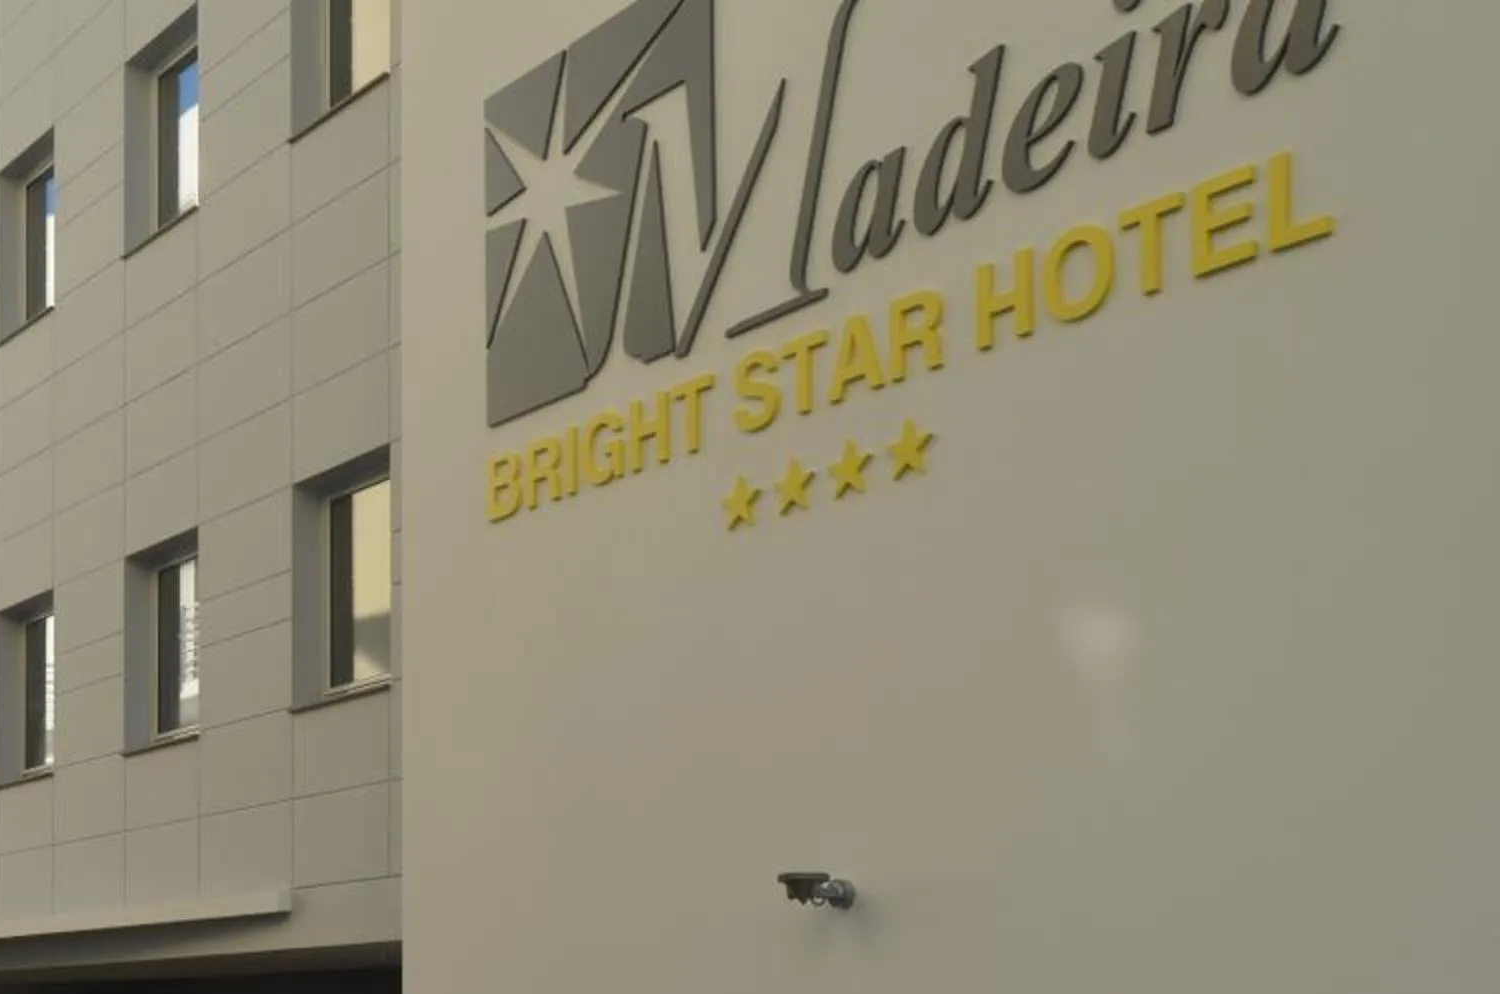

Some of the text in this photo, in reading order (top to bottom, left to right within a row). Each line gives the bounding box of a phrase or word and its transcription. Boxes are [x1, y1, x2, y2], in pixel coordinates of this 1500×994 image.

[484, 151, 1336, 524] BRIGHT STAR HOTEL
[586, 0, 1342, 382] Madeira
